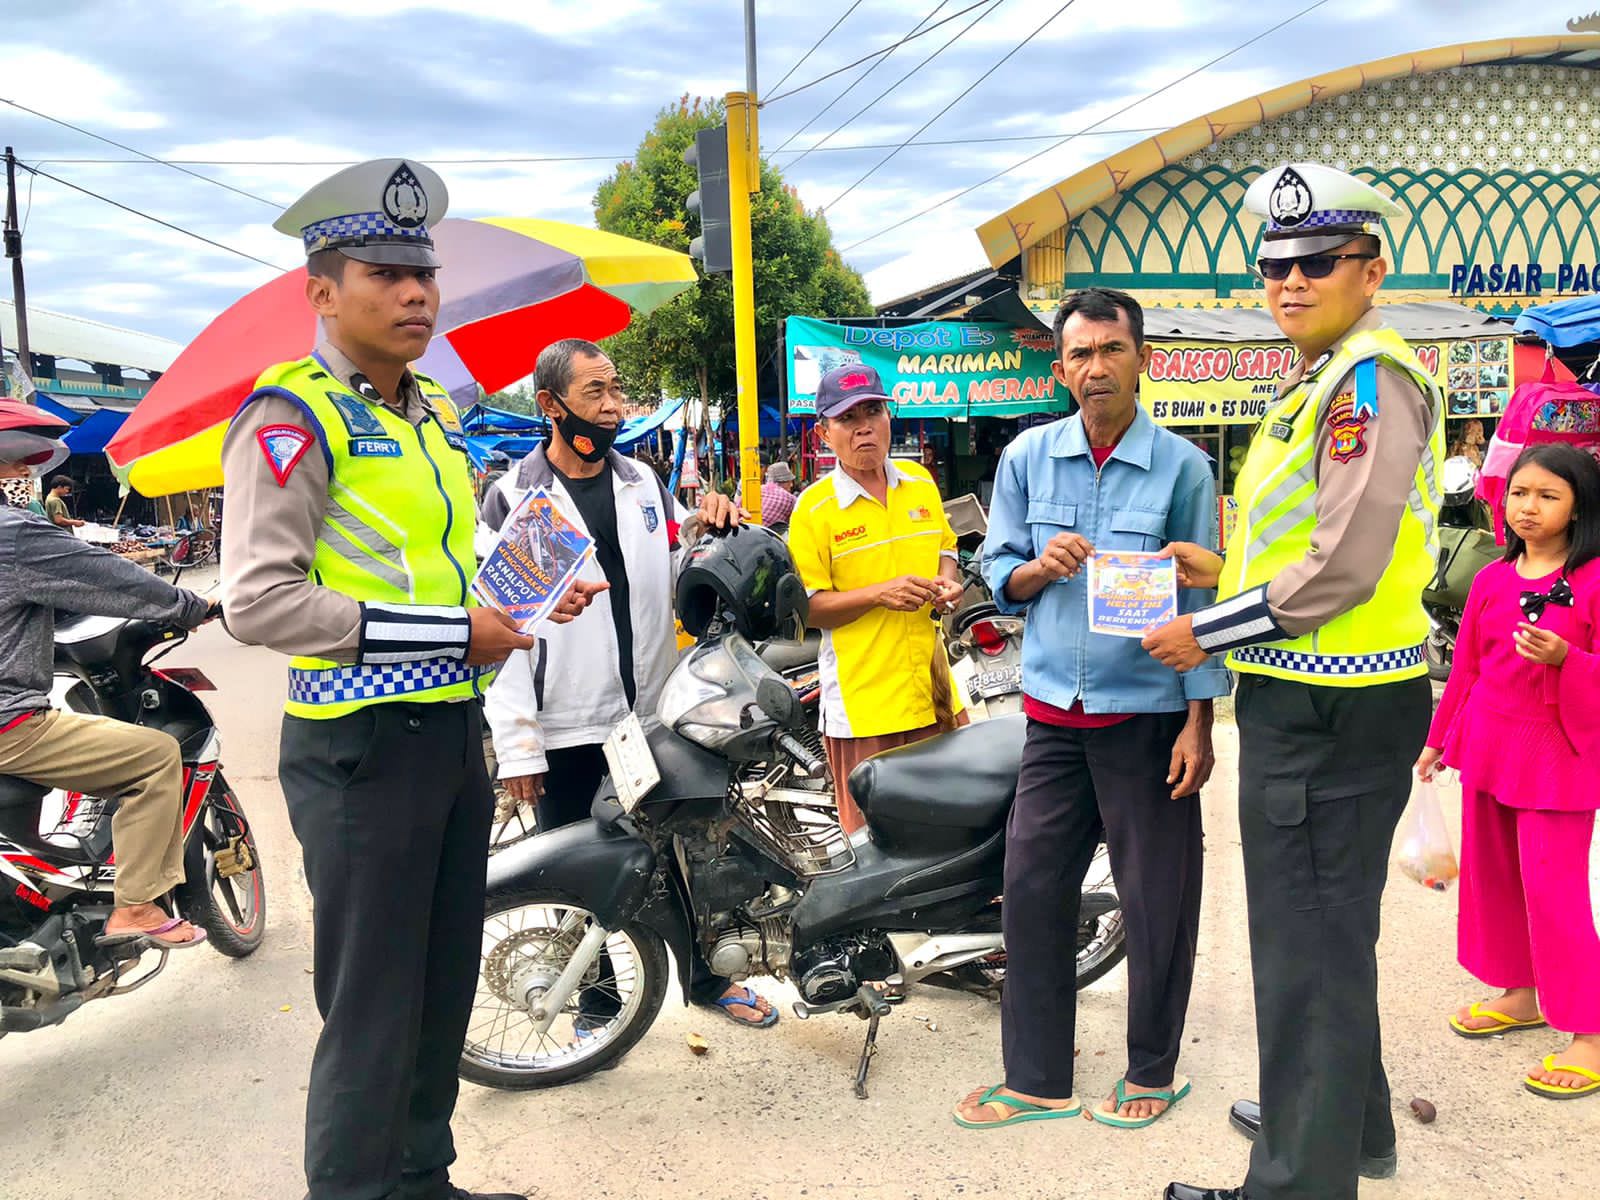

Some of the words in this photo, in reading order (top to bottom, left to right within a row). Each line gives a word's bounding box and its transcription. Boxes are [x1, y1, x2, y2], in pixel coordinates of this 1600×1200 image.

[1452, 264, 1542, 293] PASAR
[844, 326, 951, 351] Depot
[897, 350, 1022, 374] MARIMAN
[1149, 348, 1231, 381] BAKSO
[892, 380, 960, 404] GULA
[968, 376, 1055, 401] MERAH
[1153, 401, 1168, 418] ES
[1171, 401, 1205, 418] BUAH
[1222, 400, 1236, 417] ES
[357, 440, 397, 453] FERRY
[497, 546, 549, 597] MENGGUNAKAN
[506, 542, 552, 585] DILARANG
[495, 559, 537, 600] KNALPOT
[1118, 608, 1149, 617] SAAT
